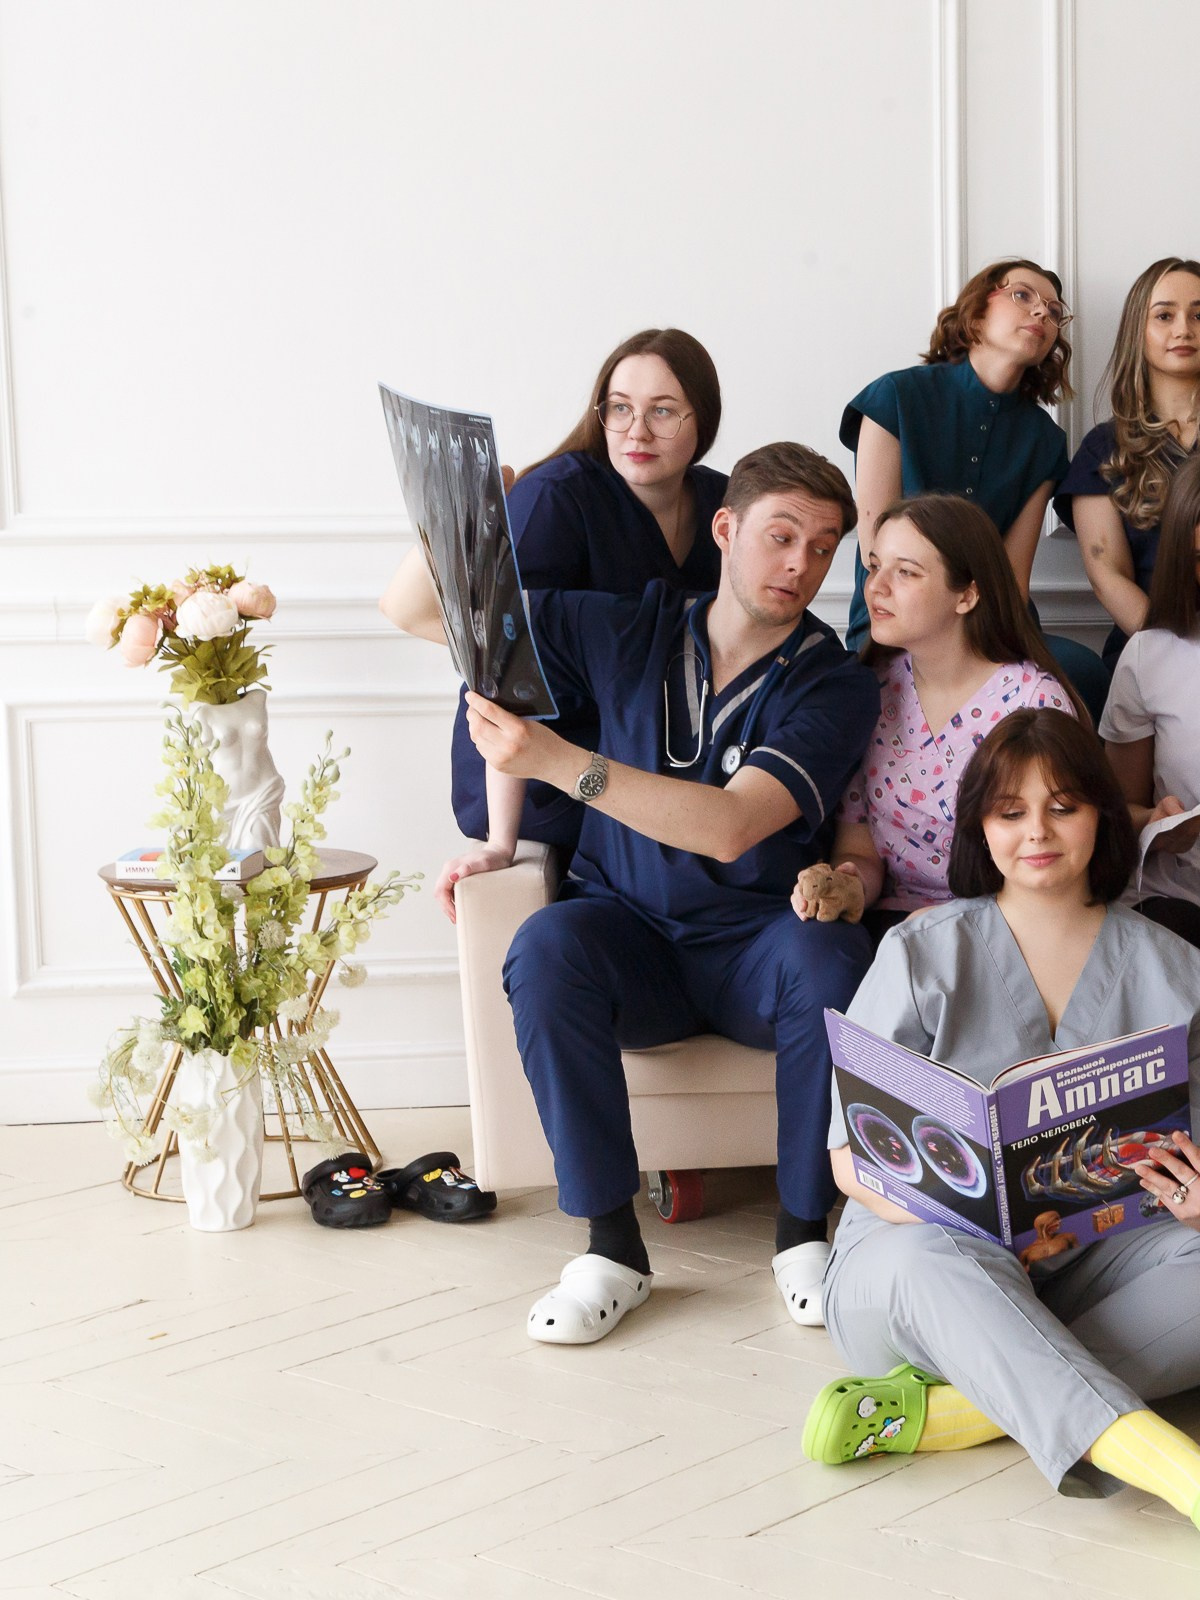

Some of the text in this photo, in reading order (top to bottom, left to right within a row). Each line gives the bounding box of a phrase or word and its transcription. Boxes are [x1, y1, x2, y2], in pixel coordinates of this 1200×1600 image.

[1056, 1057, 1105, 1080] Большой
[1057, 1045, 1164, 1088] иллюстрированный
[1027, 1058, 1166, 1128] Атлас
[989, 1104, 1000, 1141] ЧЕЛОВЕКА
[1011, 1114, 1096, 1151] ТЕЛО ЧЕЛОВЕКА
[993, 1141, 1002, 1160] ТЕЛО
